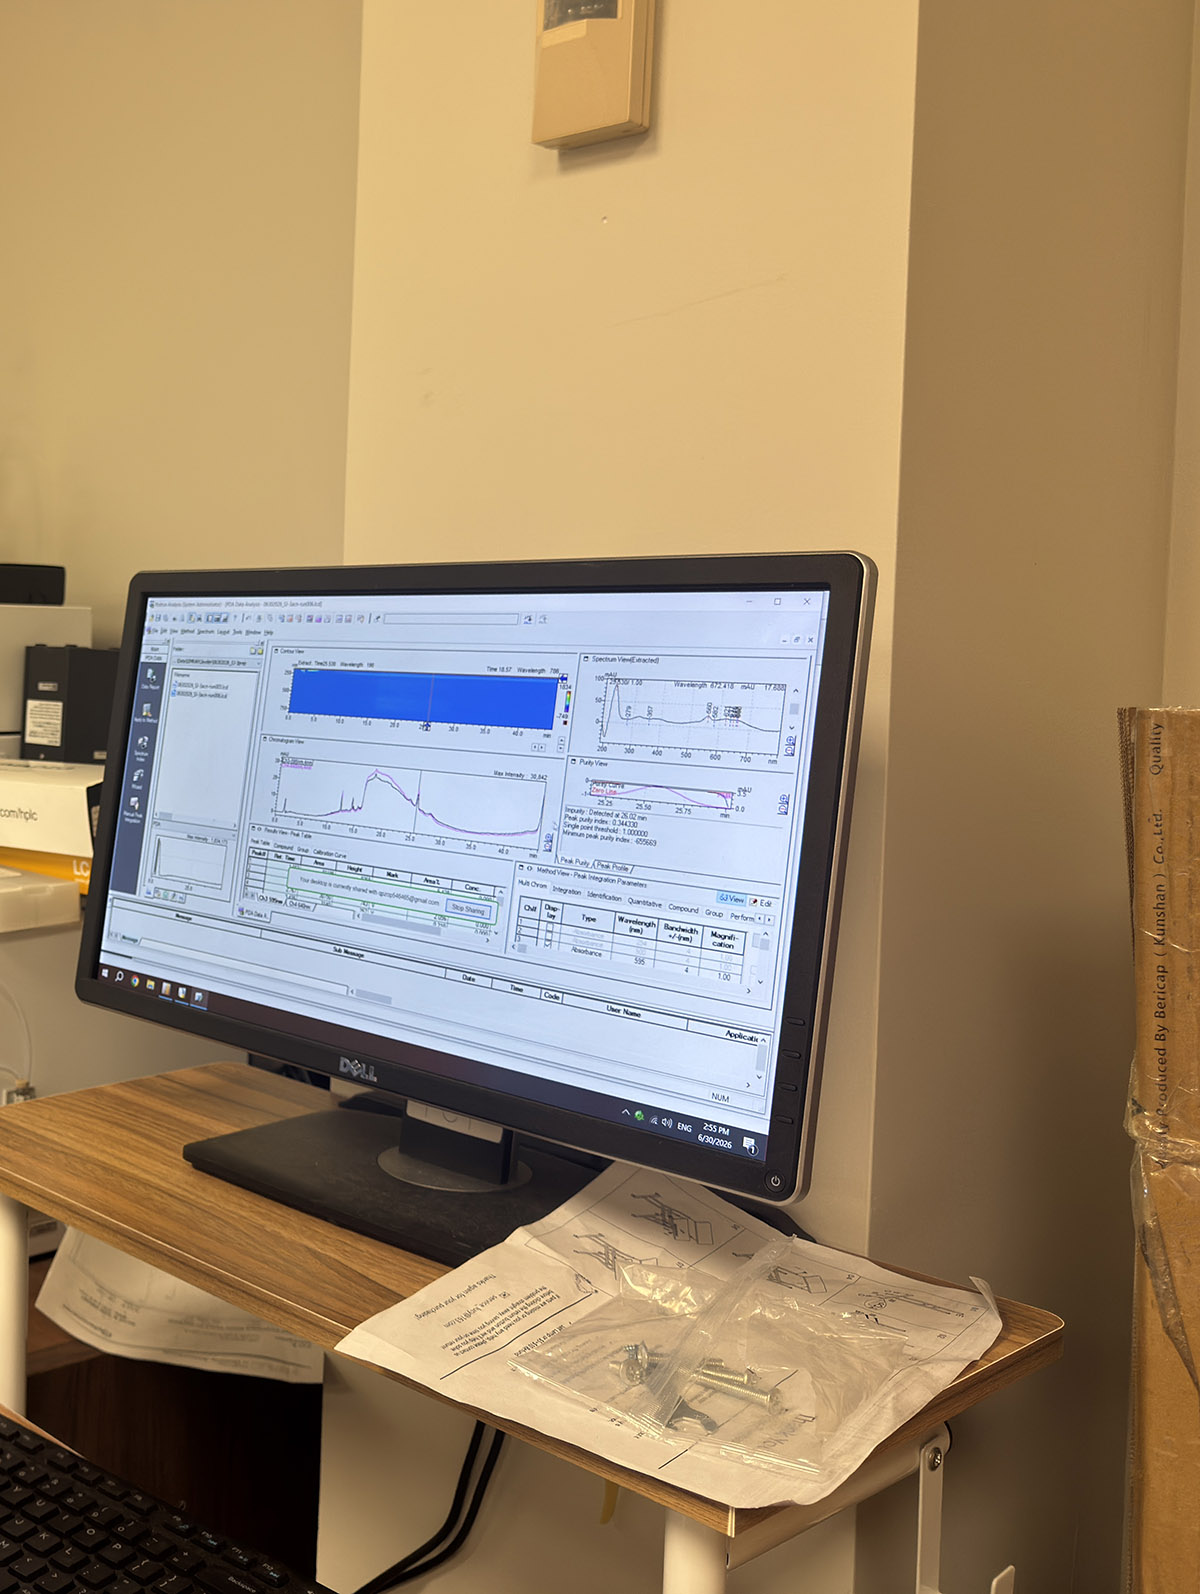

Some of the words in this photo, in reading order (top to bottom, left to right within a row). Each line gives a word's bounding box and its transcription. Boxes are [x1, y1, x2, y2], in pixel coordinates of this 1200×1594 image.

[592, 656, 616, 664] Spectrum
[673, 681, 708, 689] Wavelength
[1149, 722, 1164, 776] Quality
[579, 760, 594, 768] Purity
[565, 806, 585, 815] Impurity
[589, 809, 615, 818] Detected
[579, 816, 594, 824] purity
[563, 822, 579, 830] Single
[593, 825, 618, 833] threshold
[562, 830, 585, 838] Minimum
[585, 832, 599, 840] peak
[600, 834, 615, 842] purity
[615, 835, 630, 843] index
[575, 858, 590, 867] Purity
[610, 863, 629, 871] Profile
[537, 866, 557, 875] Method
[573, 871, 587, 879] Peak
[587, 872, 617, 883] Integration
[617, 877, 648, 888] Parameters
[531, 881, 548, 889] Chrom
[552, 885, 582, 895] Integration
[587, 890, 623, 902] Identification
[627, 897, 663, 909] Quantitative
[668, 903, 699, 914] Compound
[705, 908, 724, 918] Group
[729, 894, 745, 904] View
[760, 899, 773, 907] Edit
[452, 903, 465, 912] Stop
[465, 905, 486, 916] Sharing
[1152, 882, 1166, 948] Kunshan
[582, 913, 597, 923] Type
[617, 915, 657, 928] Wavelength
[663, 923, 700, 935] Bandwidth
[711, 930, 740, 941] Magnifi-
[712, 940, 735, 950] cation
[571, 946, 603, 958] Absorbance
[718, 972, 731, 981] 1.00
[462, 973, 476, 982] Date
[510, 984, 524, 993] Time
[544, 991, 561, 1001] Code
[606, 1004, 621, 1014] User
[622, 1008, 642, 1018] Name
[1152, 965, 1169, 1019] Bericap
[1153, 1021, 1170, 1041] By
[339, 1056, 378, 1083] DELL
[711, 1092, 730, 1102] NUM
[677, 1121, 693, 1133] ENG
[703, 1122, 718, 1133] 2:55
[718, 1125, 731, 1136] PM
[697, 1133, 734, 1149] 6/30/2026
